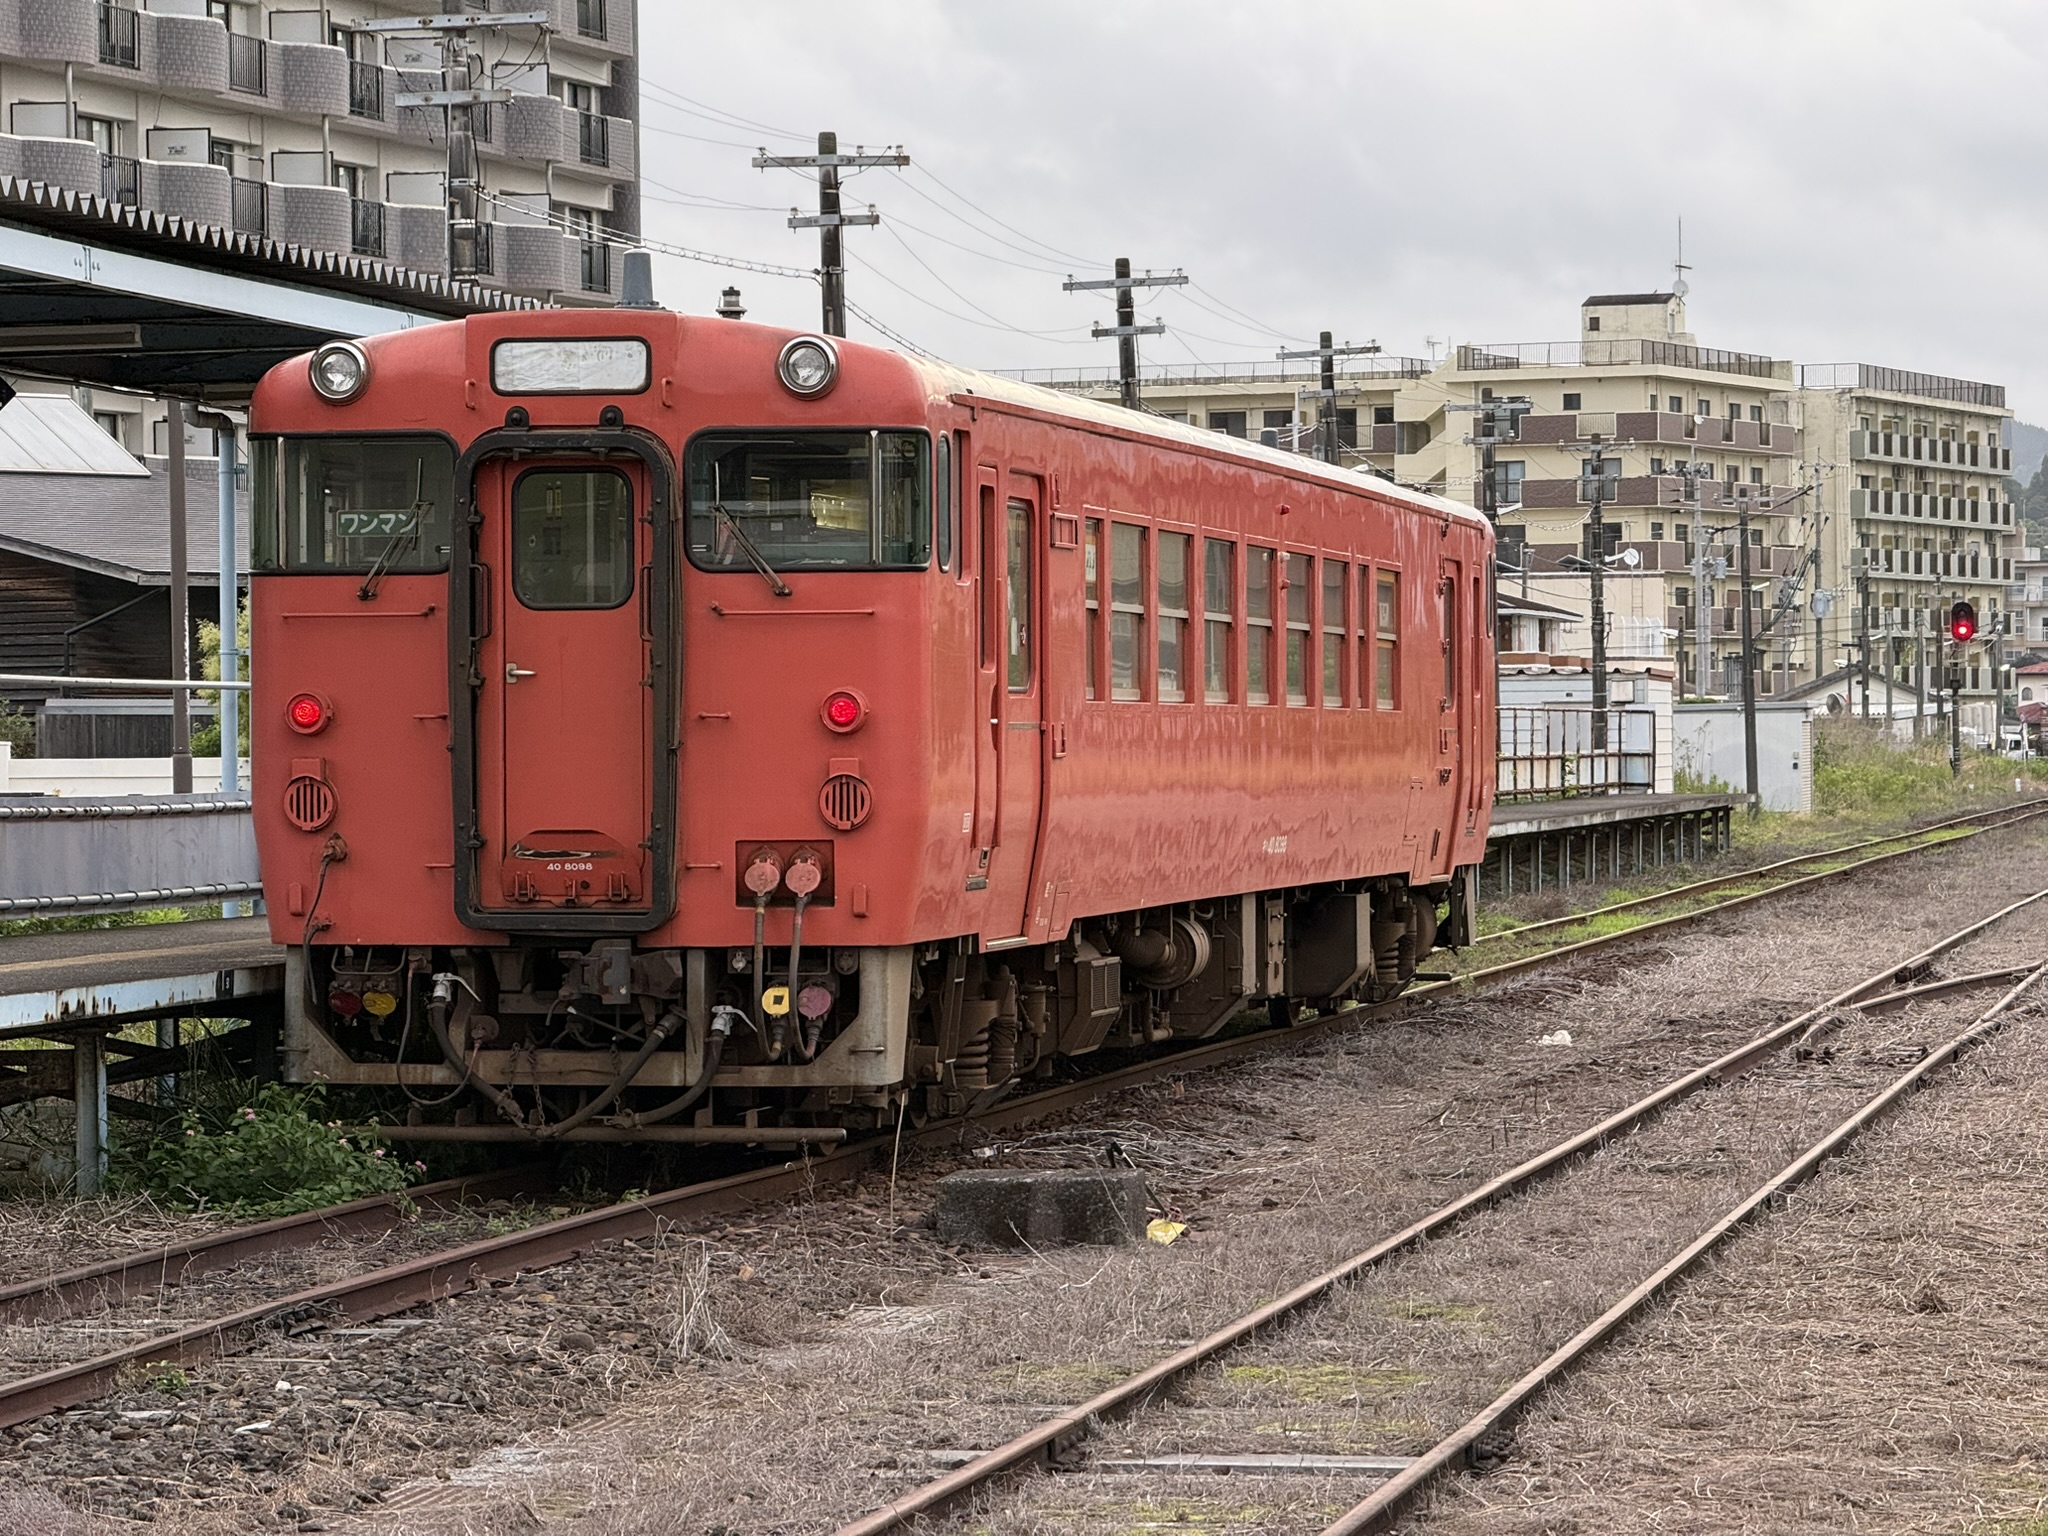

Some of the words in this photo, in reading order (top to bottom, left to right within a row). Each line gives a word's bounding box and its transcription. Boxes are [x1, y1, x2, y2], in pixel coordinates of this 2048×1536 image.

[340, 513, 417, 534] ワンマン
[546, 862, 561, 871] 40
[564, 862, 593, 871] 8098
